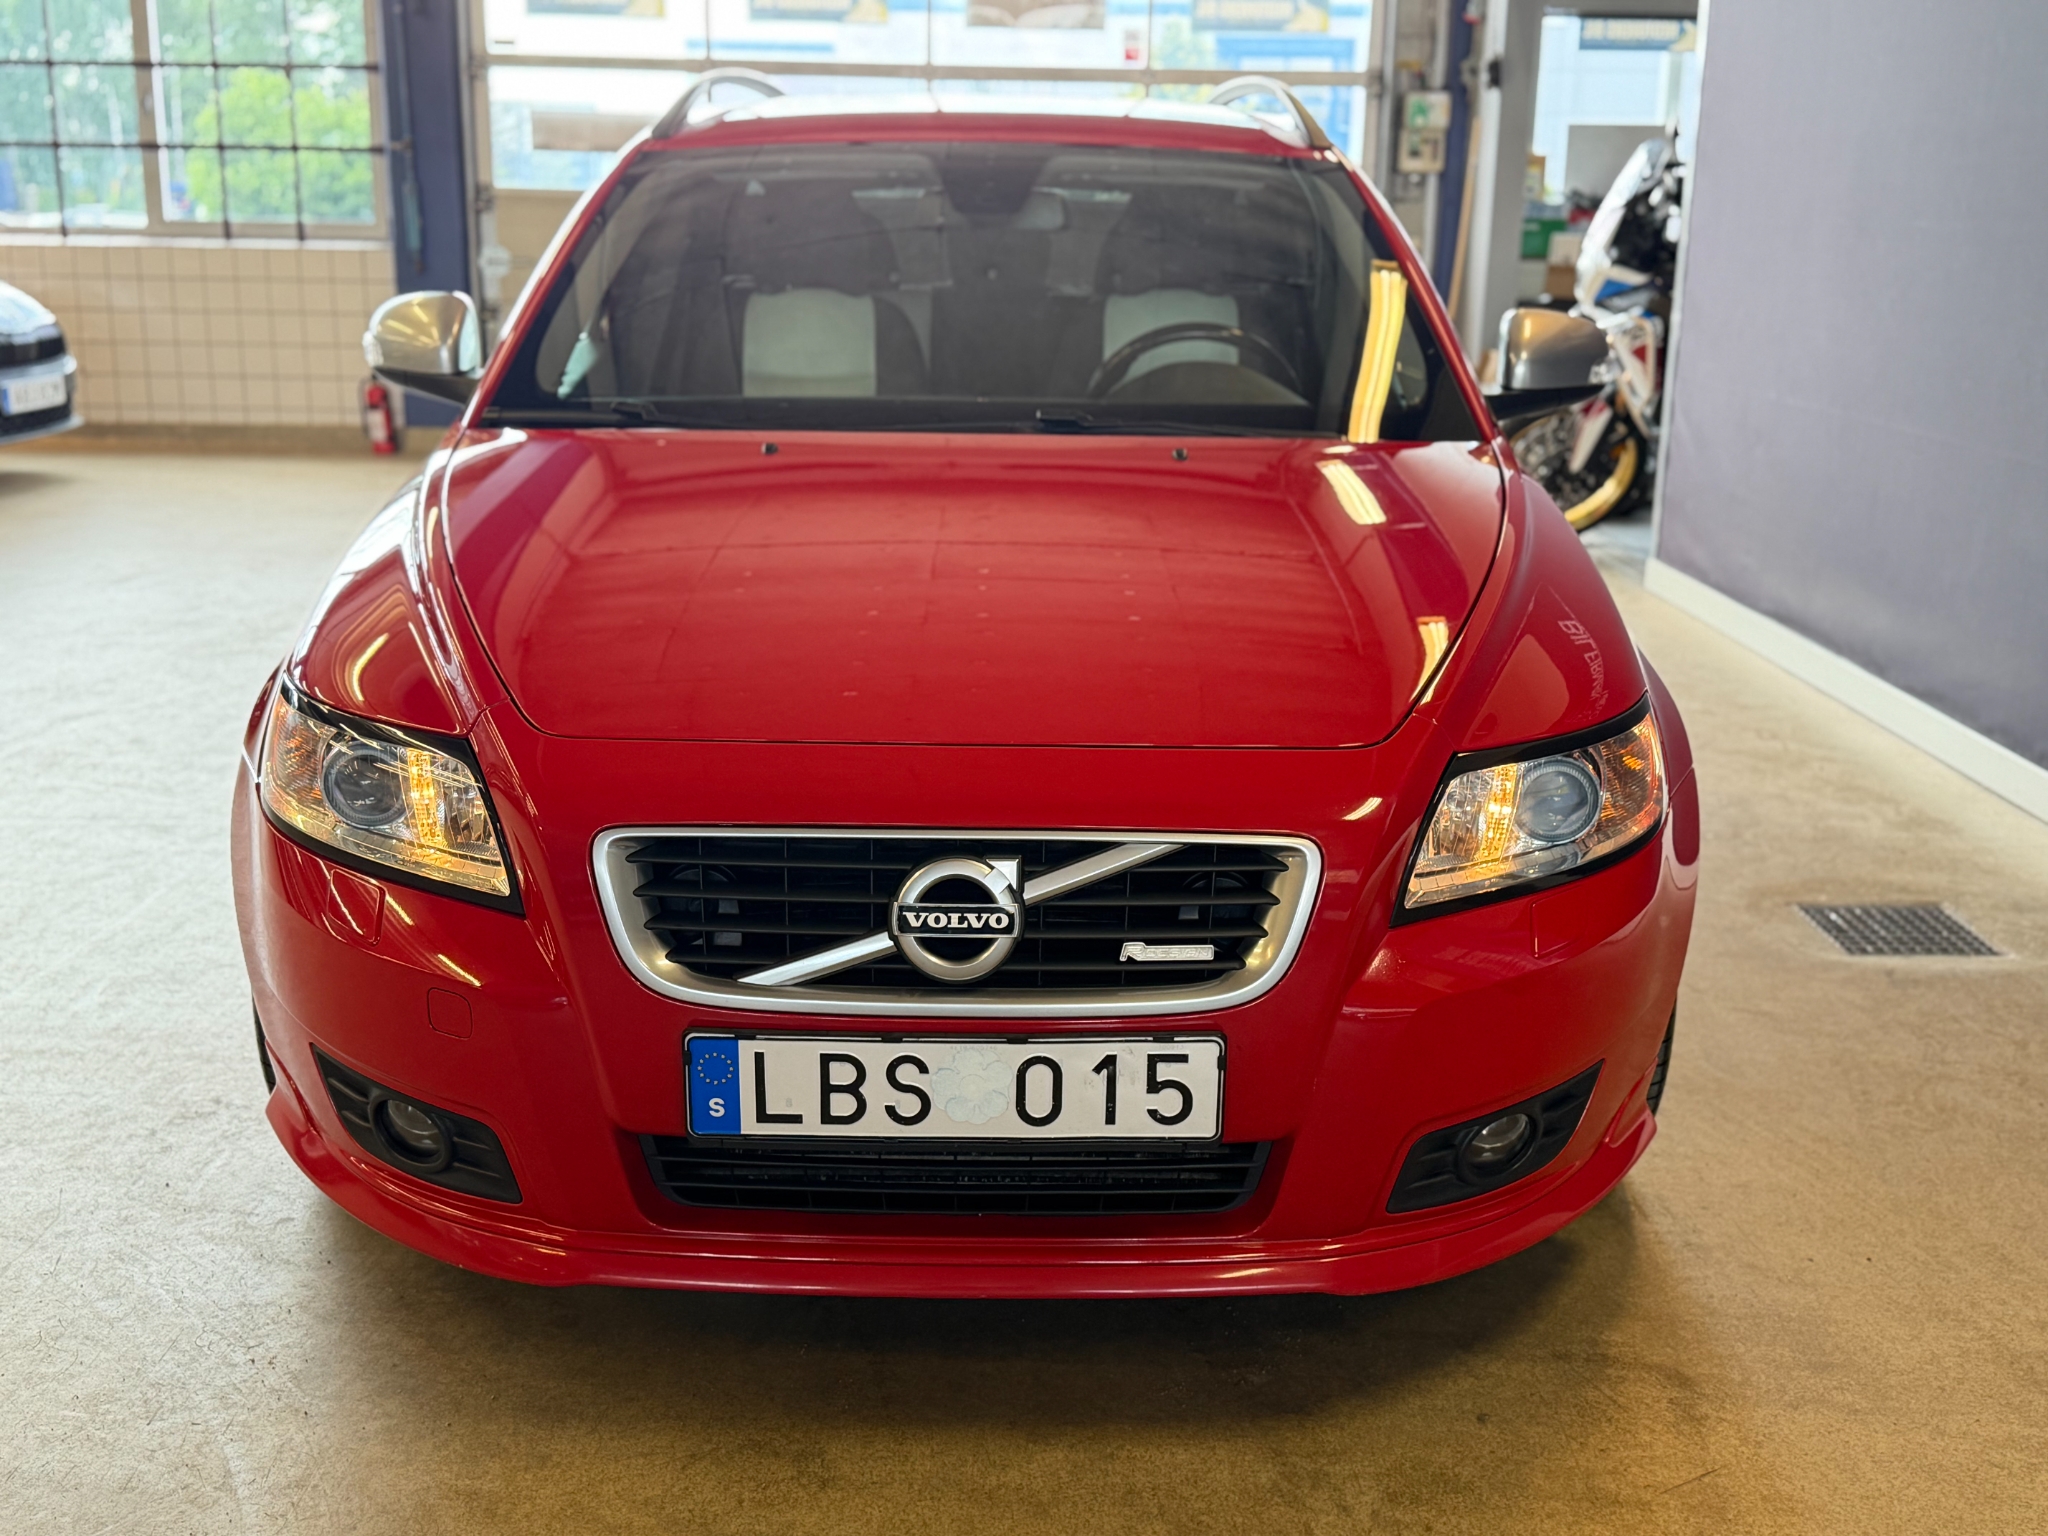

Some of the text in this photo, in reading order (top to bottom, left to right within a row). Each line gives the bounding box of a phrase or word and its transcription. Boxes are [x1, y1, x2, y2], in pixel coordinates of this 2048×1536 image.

[902, 911, 1010, 929] VOLVO
[754, 1051, 1194, 1127] LBS 015
[708, 1097, 726, 1118] S
